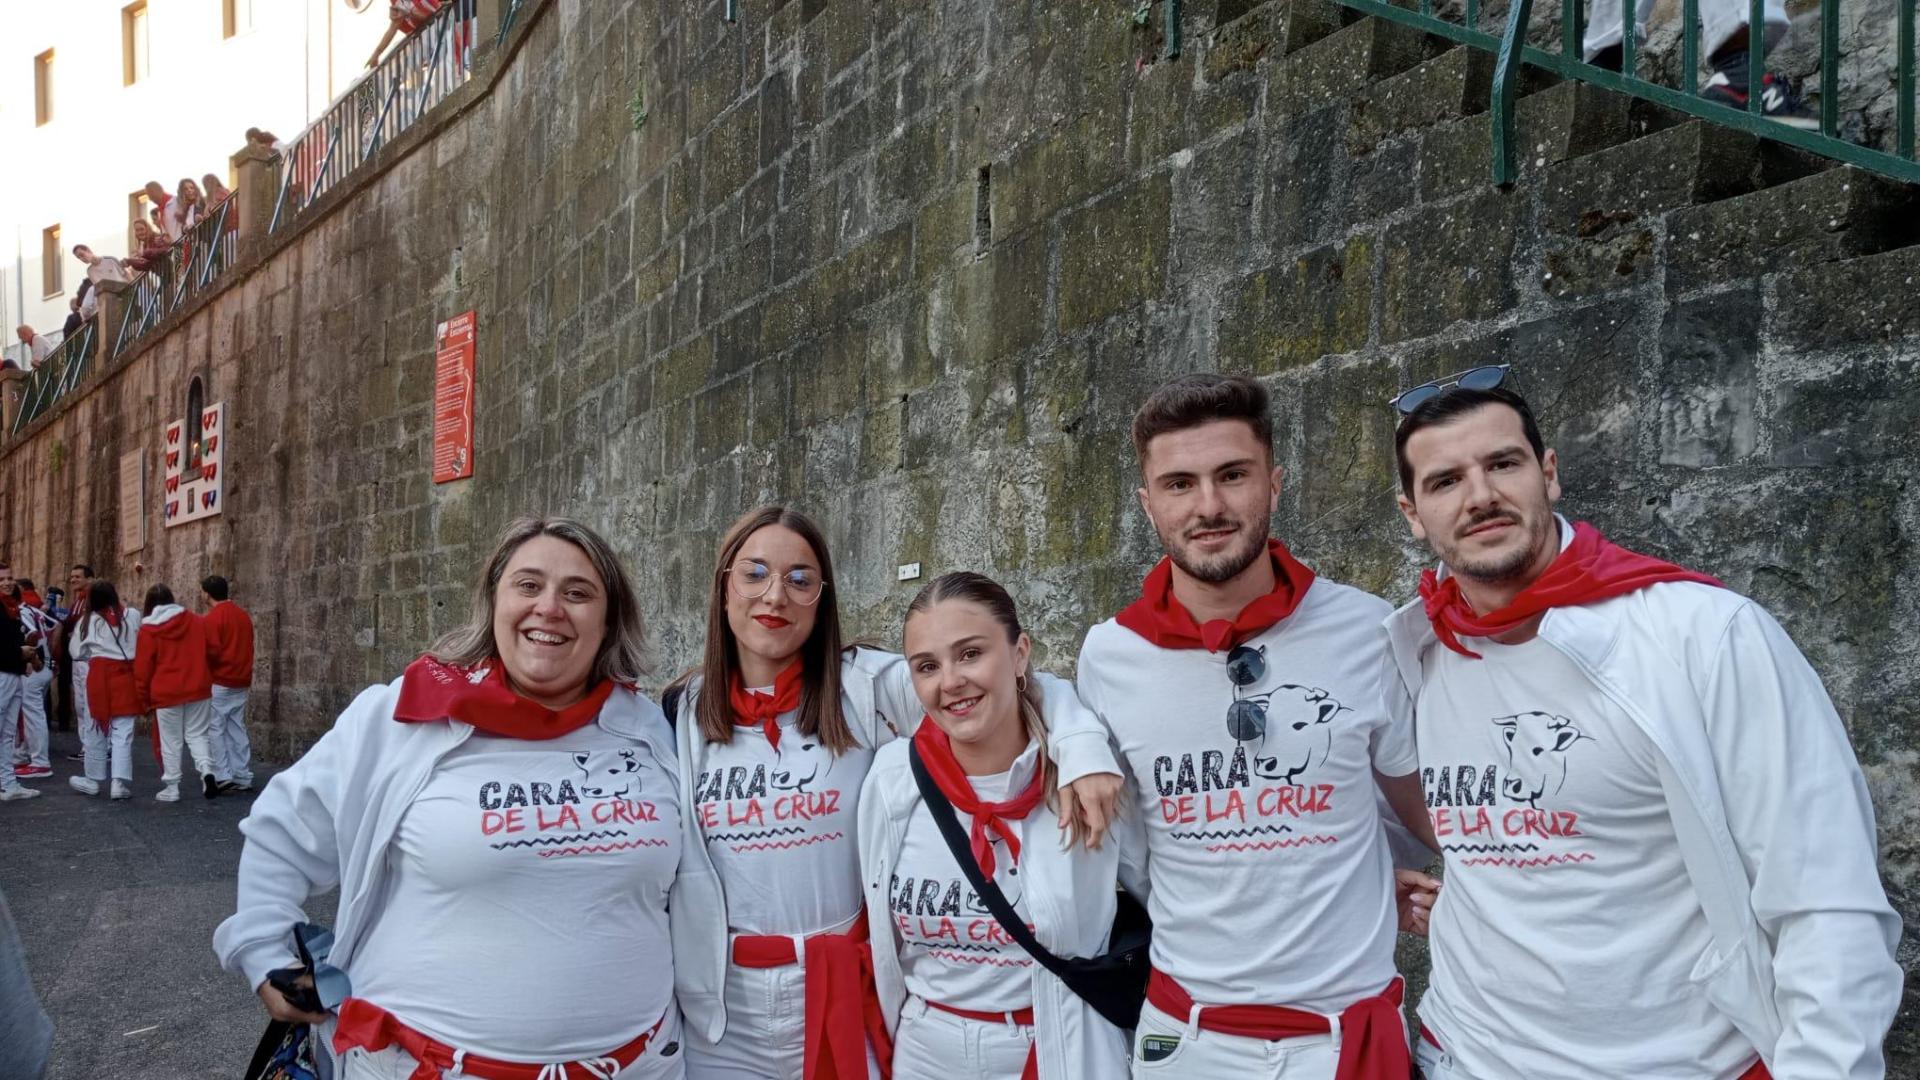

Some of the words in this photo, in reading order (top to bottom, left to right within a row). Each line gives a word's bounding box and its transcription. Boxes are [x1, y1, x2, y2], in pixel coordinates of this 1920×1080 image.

[695, 763, 767, 805] CARA
[1154, 746, 1250, 797] CARA
[1422, 764, 1497, 808] CARA
[478, 779, 581, 811] CARA
[727, 799, 765, 826] LA
[773, 790, 841, 821] CRUZ
[1160, 796, 1198, 824] DE
[1205, 790, 1246, 824] LA
[1256, 783, 1335, 818] CRUZ
[481, 808, 525, 836] DE
[536, 805, 581, 831] LA
[591, 800, 660, 825] CRUZ
[1458, 806, 1494, 840] LA
[1502, 808, 1583, 839] CRUZ
[889, 873, 962, 917] CARA
[919, 917, 959, 944] LA
[967, 918, 1036, 946] CR
